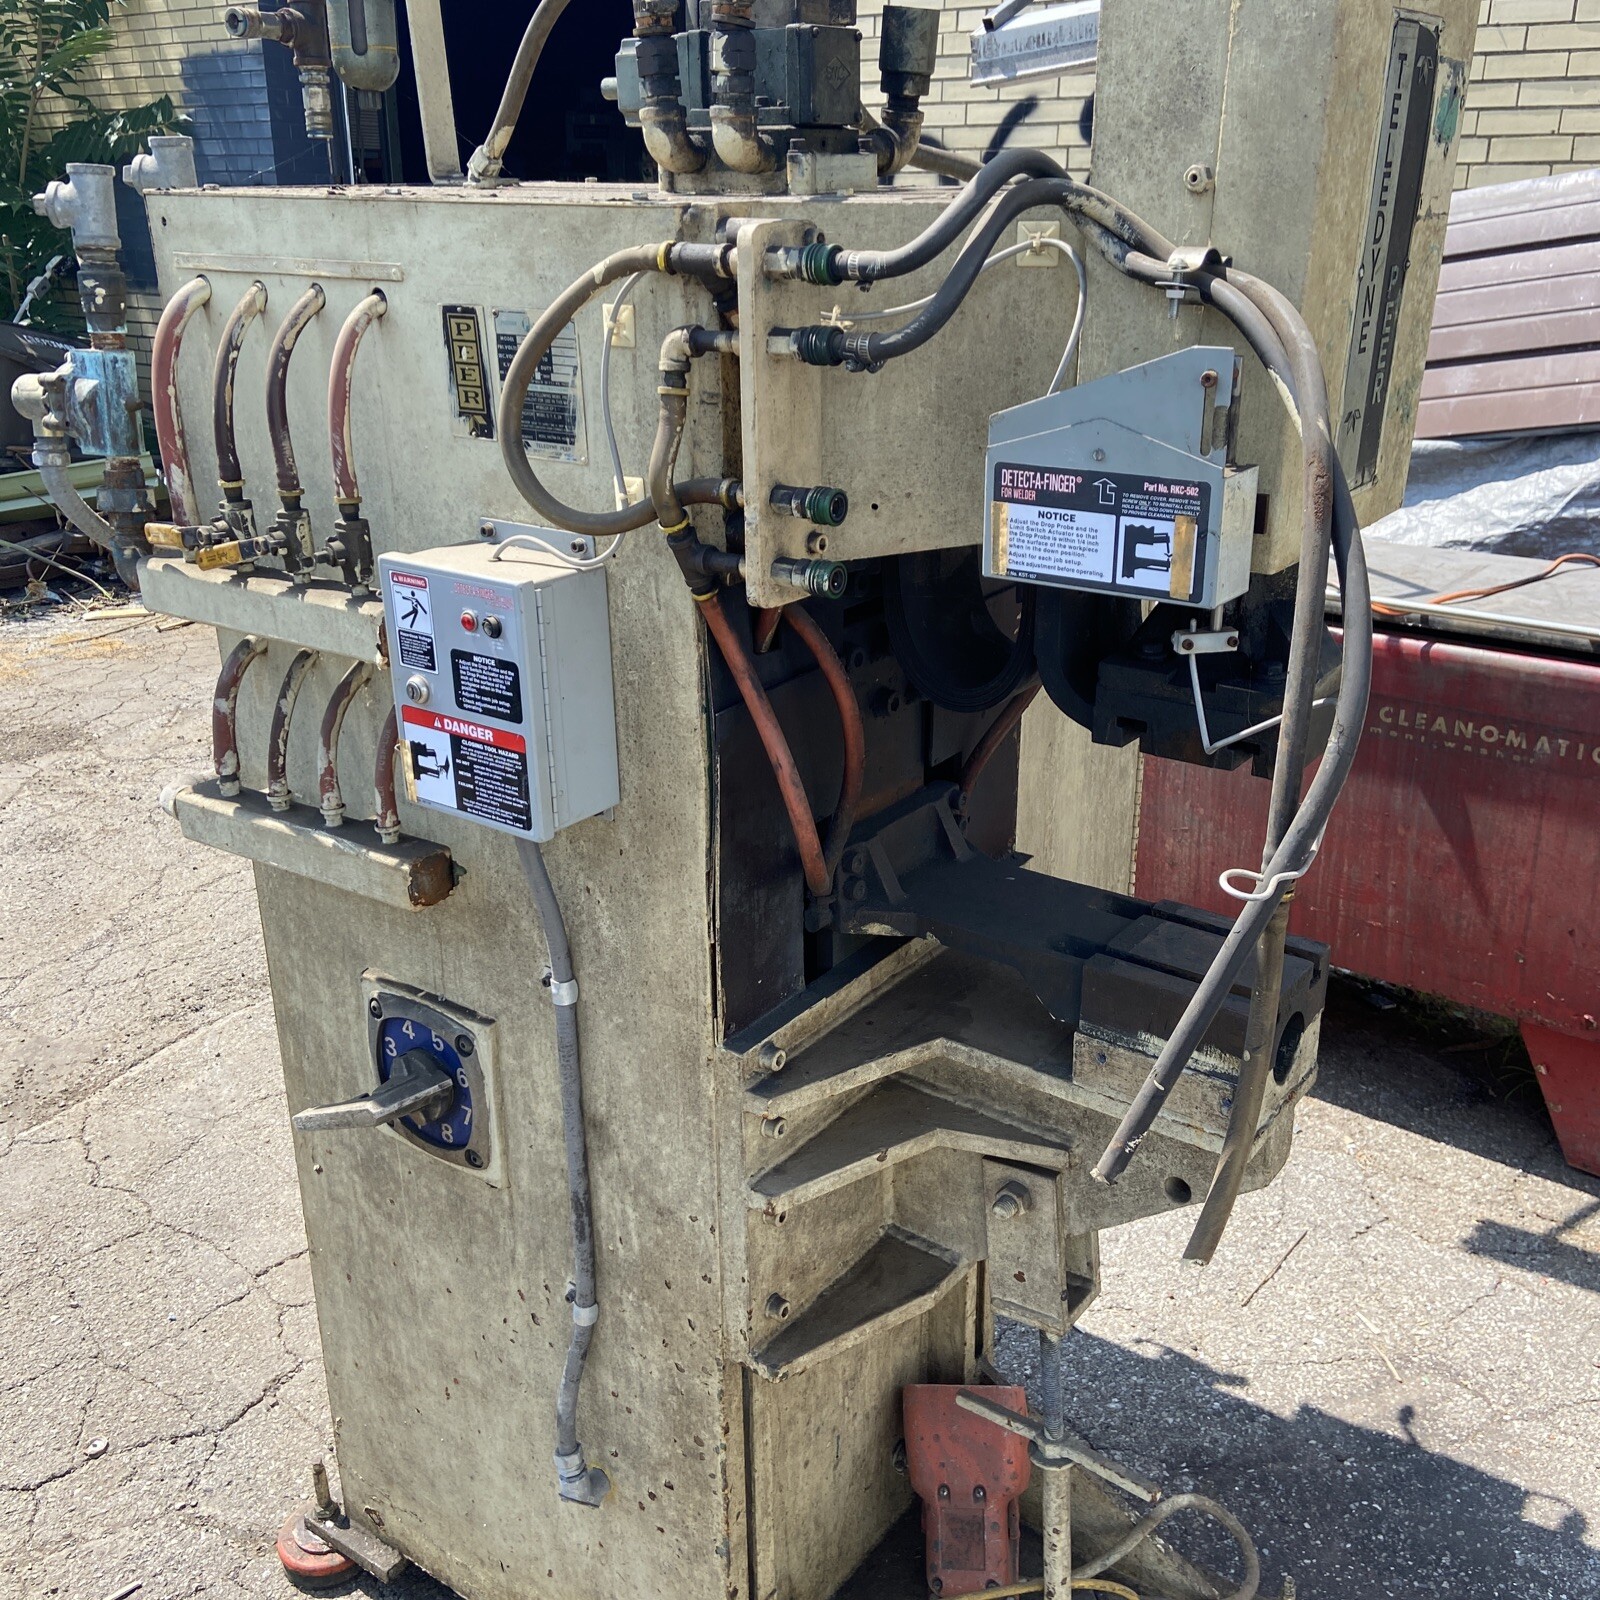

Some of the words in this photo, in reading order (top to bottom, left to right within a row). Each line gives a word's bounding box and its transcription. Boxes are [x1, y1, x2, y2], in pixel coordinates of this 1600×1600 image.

[1358, 53, 1408, 355] TELEDYNE
[1372, 264, 1399, 405] PEER
[454, 322, 480, 405] PEER
[1001, 488, 1012, 498] FOR
[1013, 490, 1036, 500] WELDER
[1144, 481, 1157, 493] Part
[1158, 483, 1169, 494] No.
[1170, 484, 1199, 498] RKC-502
[1010, 518, 1029, 526] Adjust
[1040, 521, 1055, 530] Drop
[1057, 523, 1074, 531] Probe
[1038, 510, 1076, 522] NOTICE
[1019, 531, 1033, 539] Drop
[1026, 526, 1046, 534] Switch
[1048, 528, 1074, 537] Actuator
[1027, 539, 1048, 547] surface
[1068, 543, 1099, 553] workpiece
[1060, 549, 1087, 559] position.
[1008, 551, 1027, 560] Adjust
[1038, 554, 1052, 562] each
[1053, 556, 1063, 564] job
[1065, 557, 1083, 567] setup.
[1008, 559, 1025, 567] Check
[1026, 561, 1056, 572] adjustment
[1057, 564, 1075, 572] before
[1076, 567, 1104, 578] operating.
[398, 576, 425, 586] WARNING
[473, 656, 496, 666] NOTICE
[444, 718, 494, 742] DANGER
[461, 739, 483, 750] CLOSING
[484, 744, 497, 754] TOOL
[498, 748, 519, 759] HAZARD
[458, 770, 471, 778] NEVER
[402, 1020, 416, 1040] 4
[384, 1037, 398, 1056] 3
[431, 1030, 444, 1051] 5
[456, 1068, 468, 1088] 6
[461, 1106, 472, 1125] 7
[442, 1123, 454, 1143] 8
